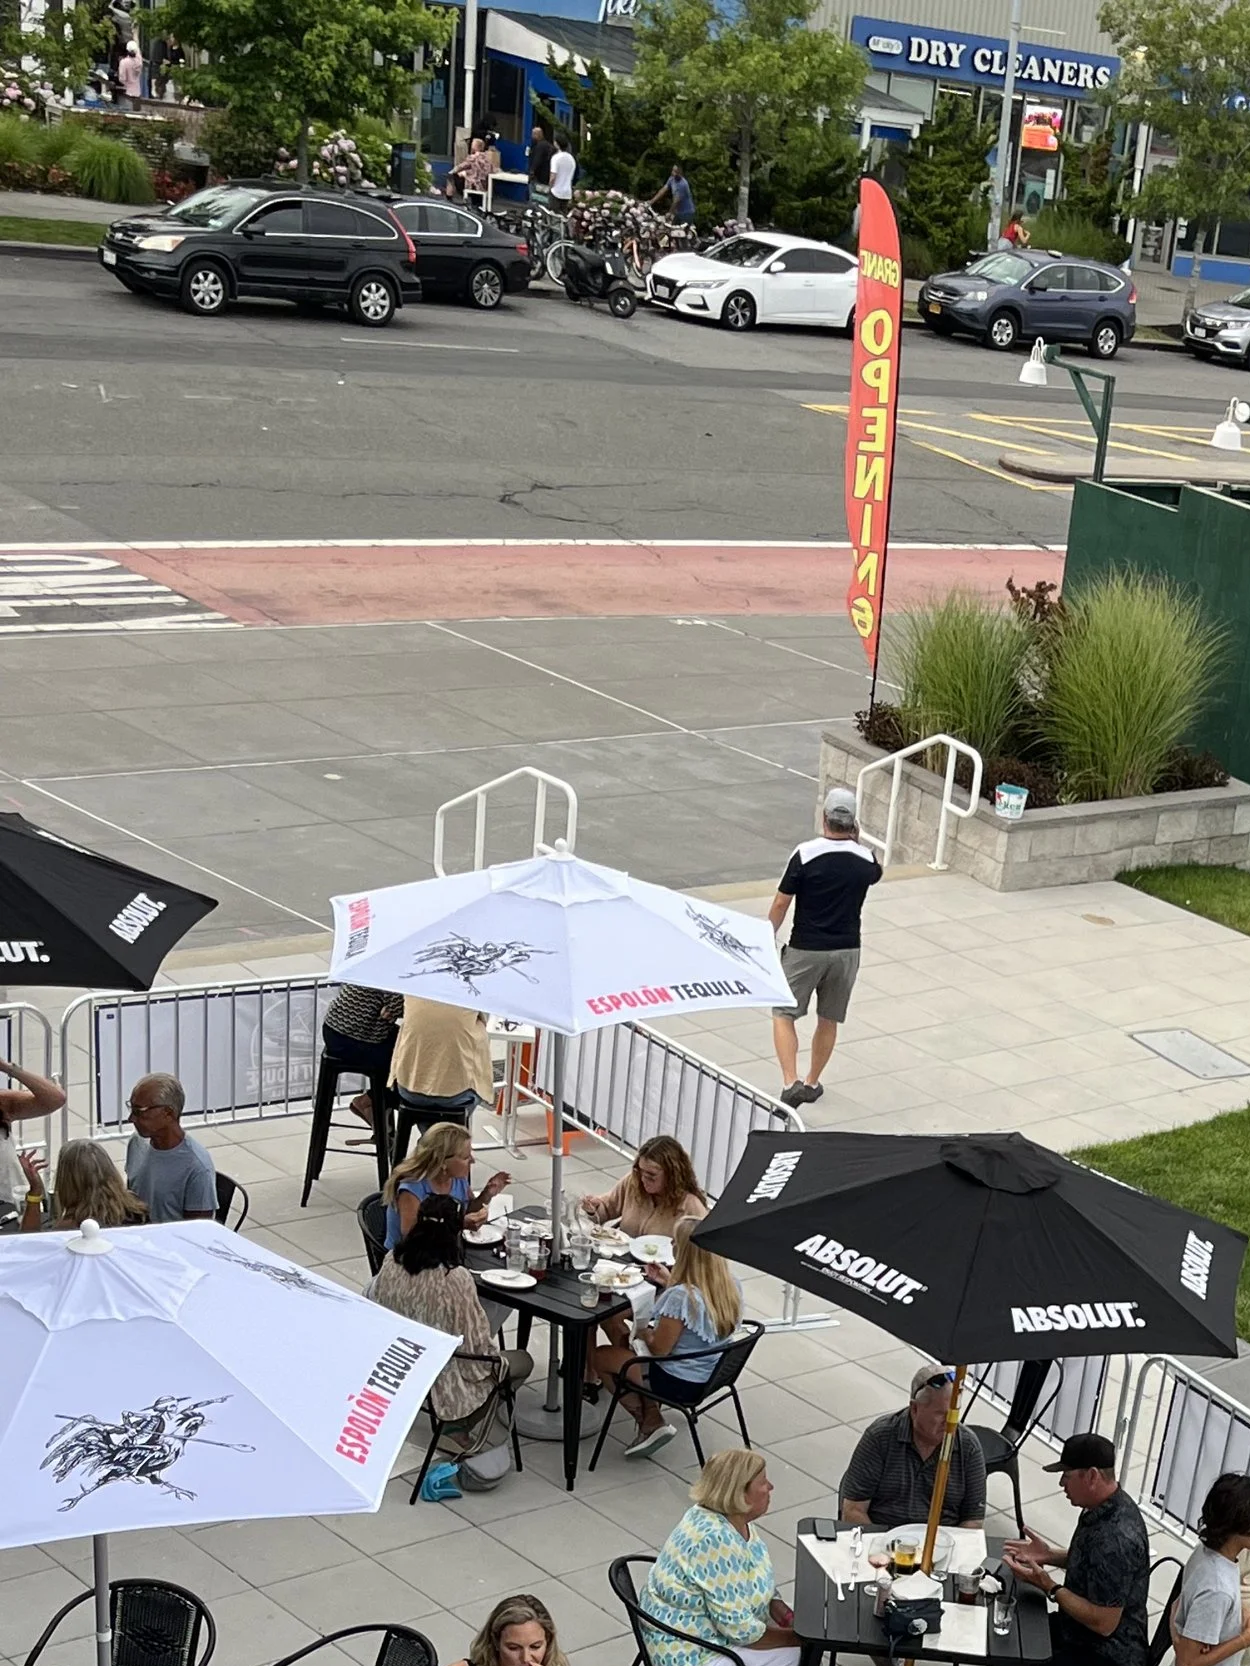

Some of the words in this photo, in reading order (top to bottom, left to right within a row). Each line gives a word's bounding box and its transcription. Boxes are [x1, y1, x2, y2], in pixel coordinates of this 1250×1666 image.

[908, 36, 967, 69] DRY
[670, 980, 752, 1001] TEQUILA
[367, 1337, 427, 1395] TEQUILA
